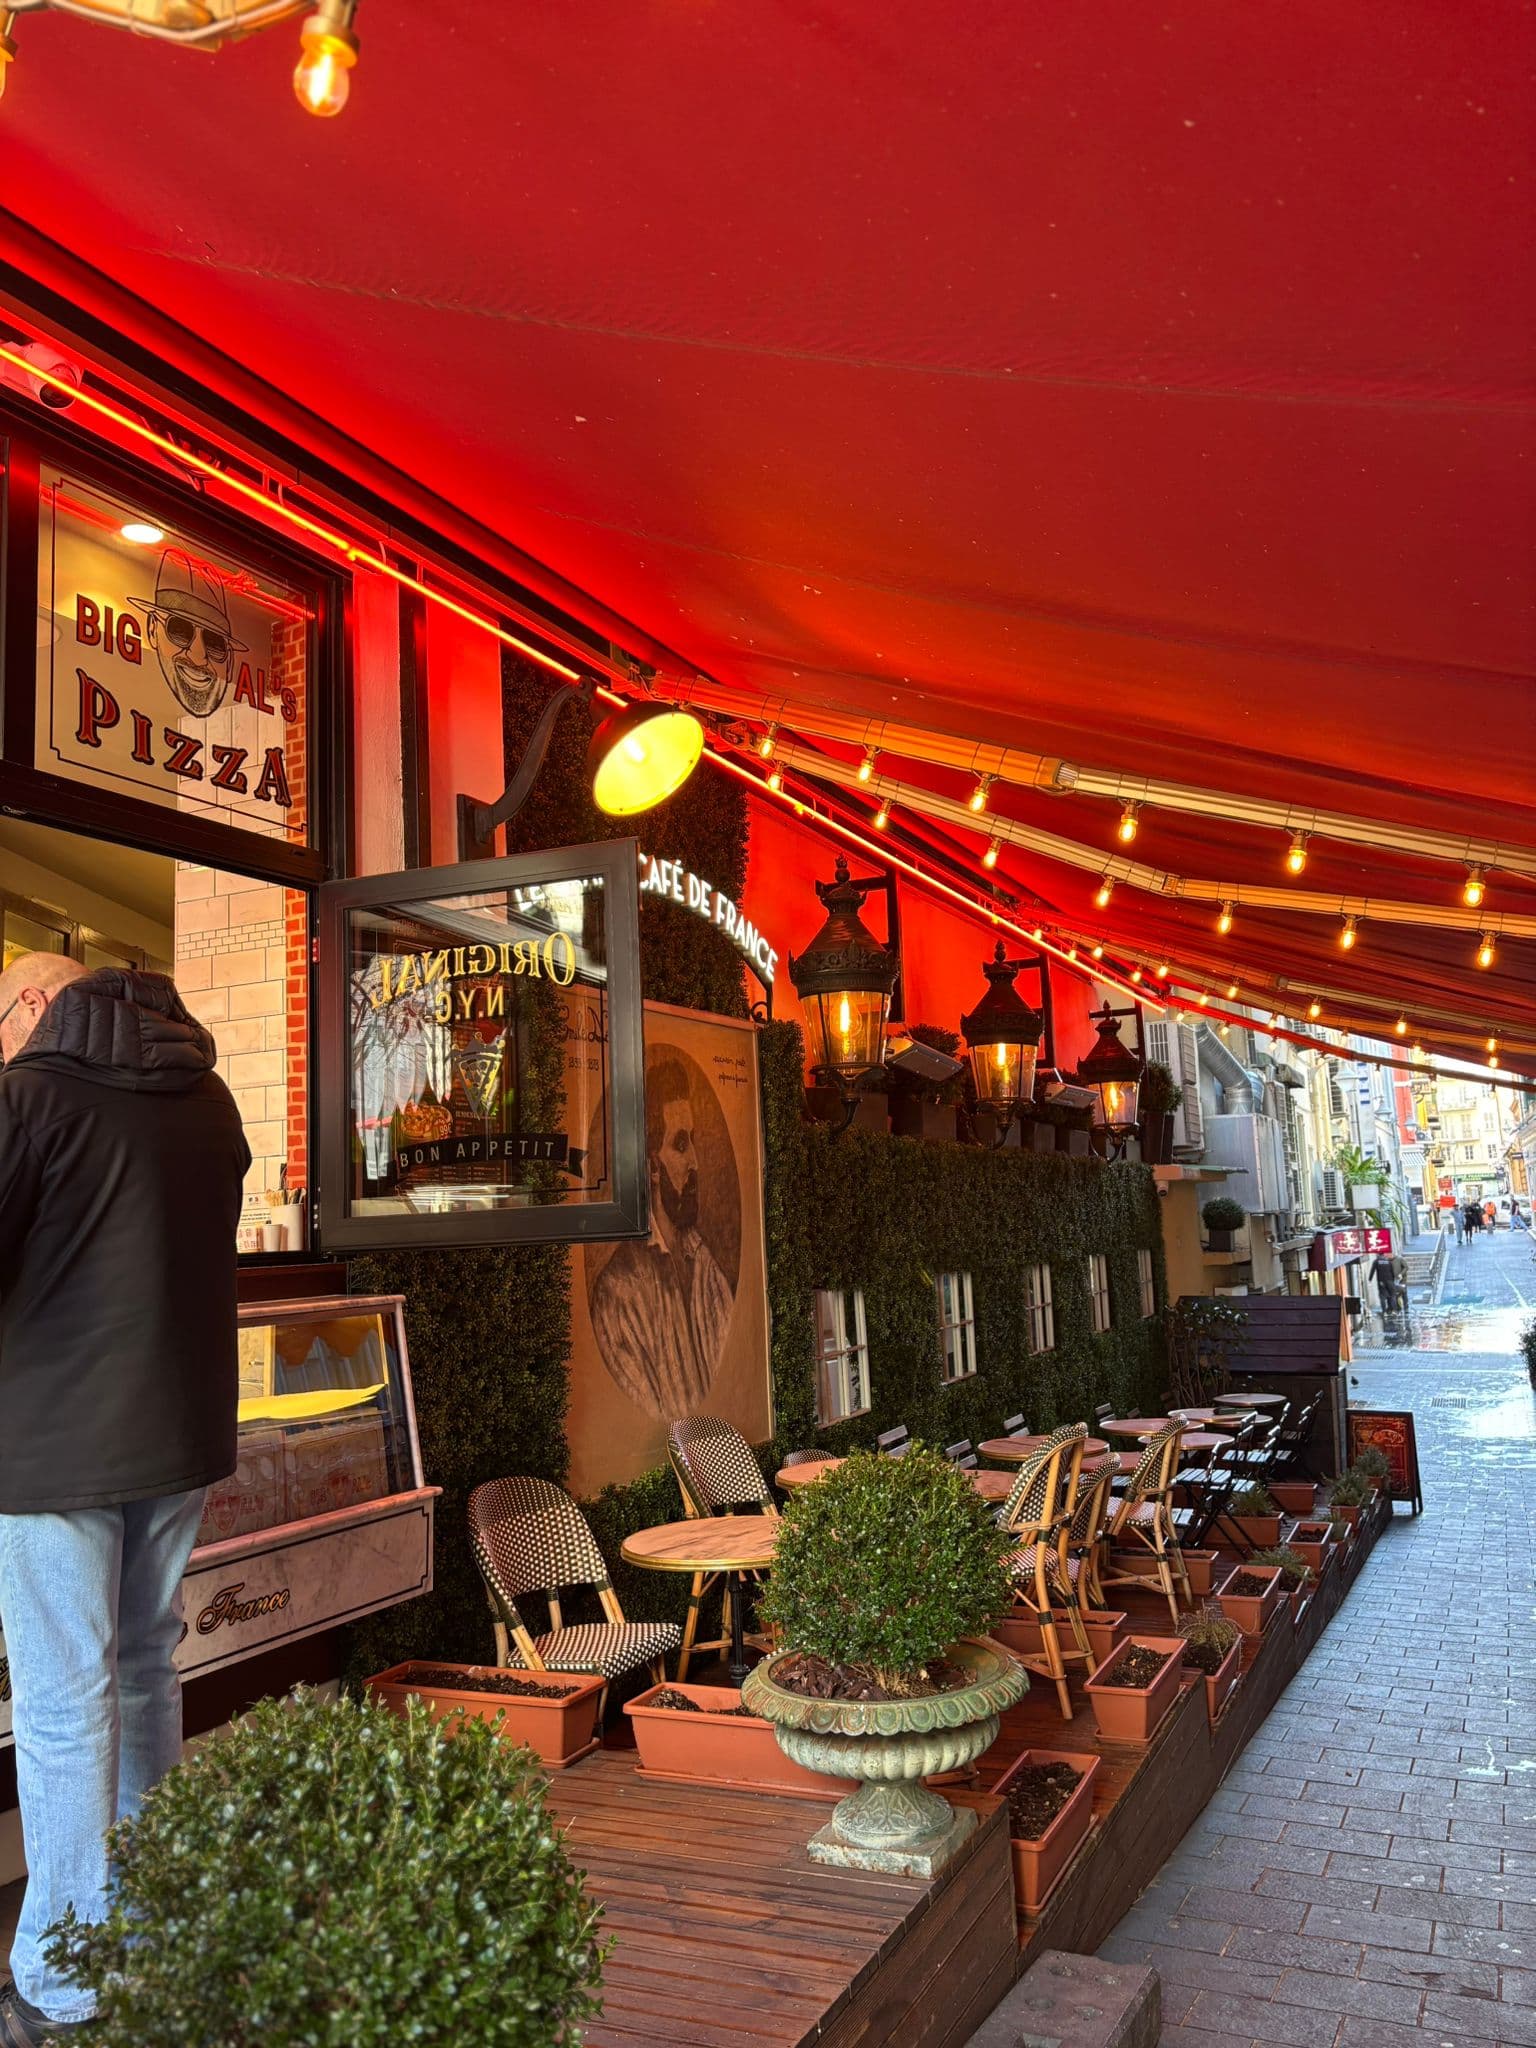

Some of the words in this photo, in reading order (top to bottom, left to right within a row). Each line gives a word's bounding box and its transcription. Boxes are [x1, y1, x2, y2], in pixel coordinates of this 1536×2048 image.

[76, 593, 142, 666] BIG
[233, 662, 297, 723] AL'S
[75, 668, 292, 808] PIZZA
[689, 872, 712, 917] DE
[717, 892, 778, 983] FRANCE
[400, 1146, 440, 1168] BON
[455, 1140, 555, 1158] APPETIT
[196, 1582, 290, 1634] France
